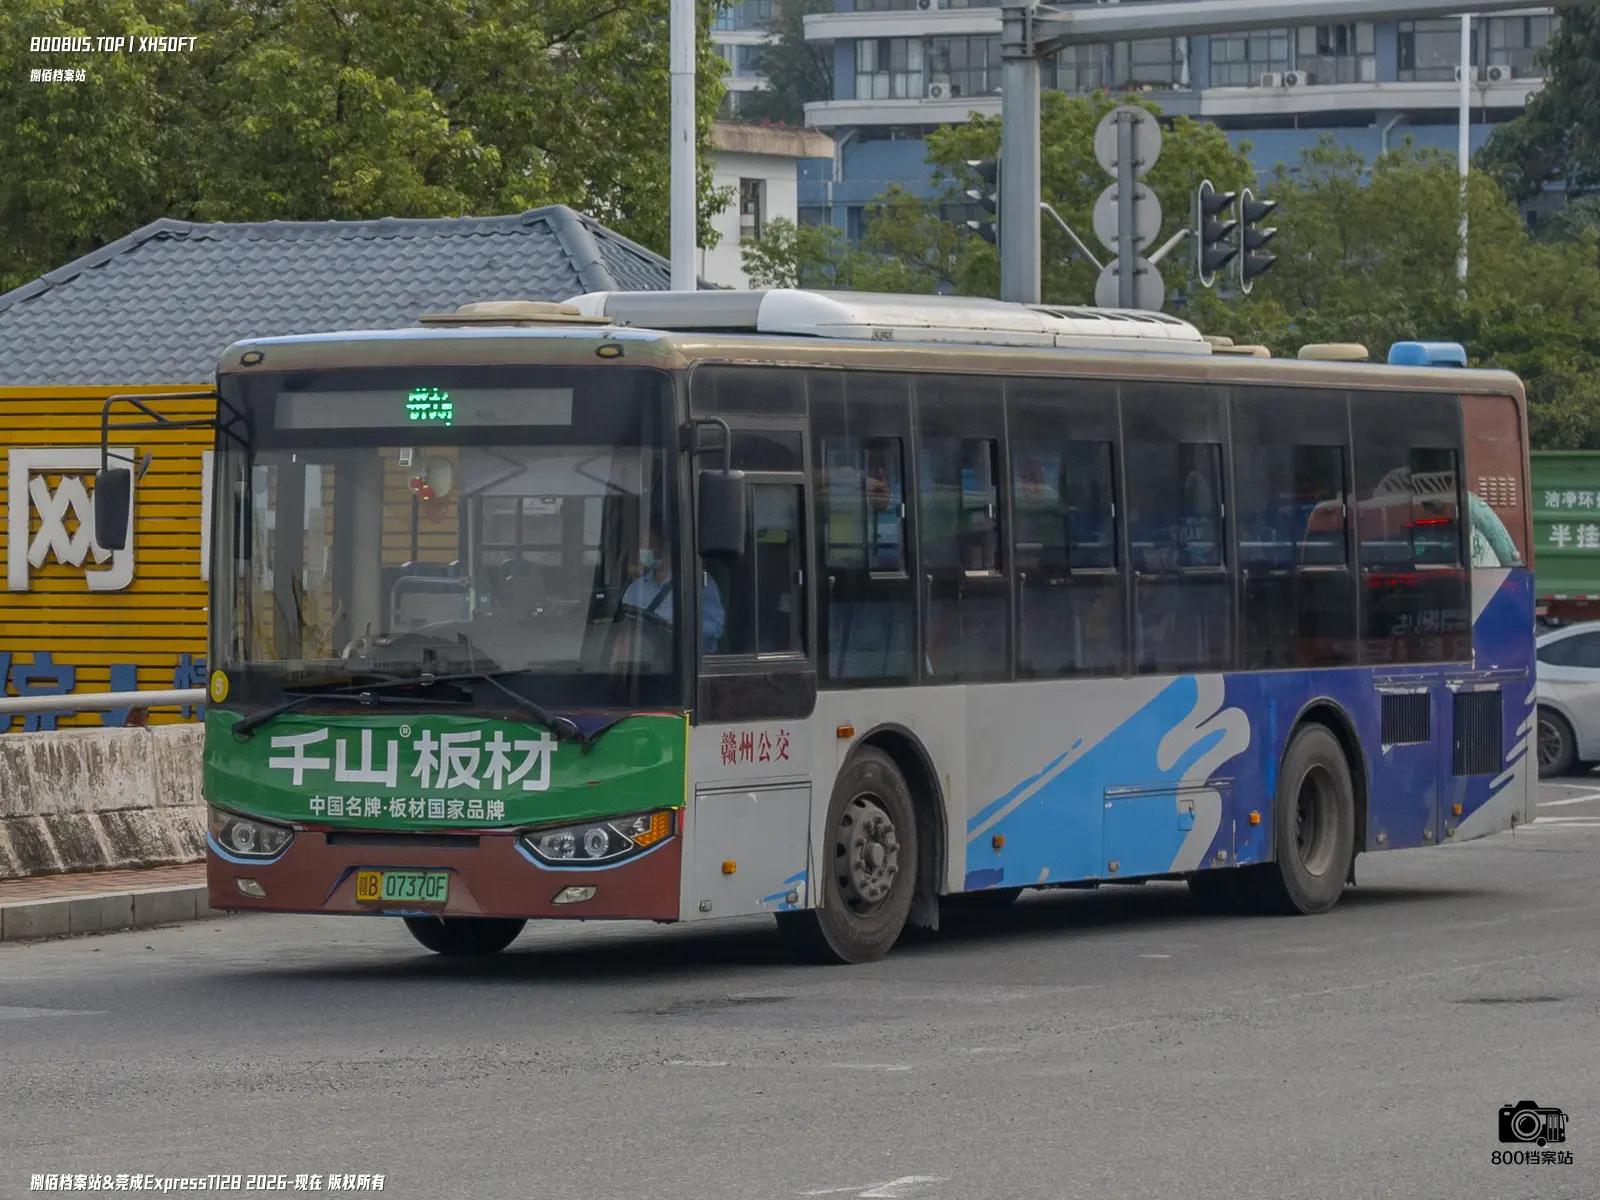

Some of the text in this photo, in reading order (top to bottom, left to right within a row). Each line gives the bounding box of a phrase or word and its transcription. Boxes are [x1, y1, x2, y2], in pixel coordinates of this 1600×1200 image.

[1544, 490, 1600, 509] 洁净环
[1549, 523, 1600, 548] 半挂
[720, 728, 790, 766] 赣州公交
